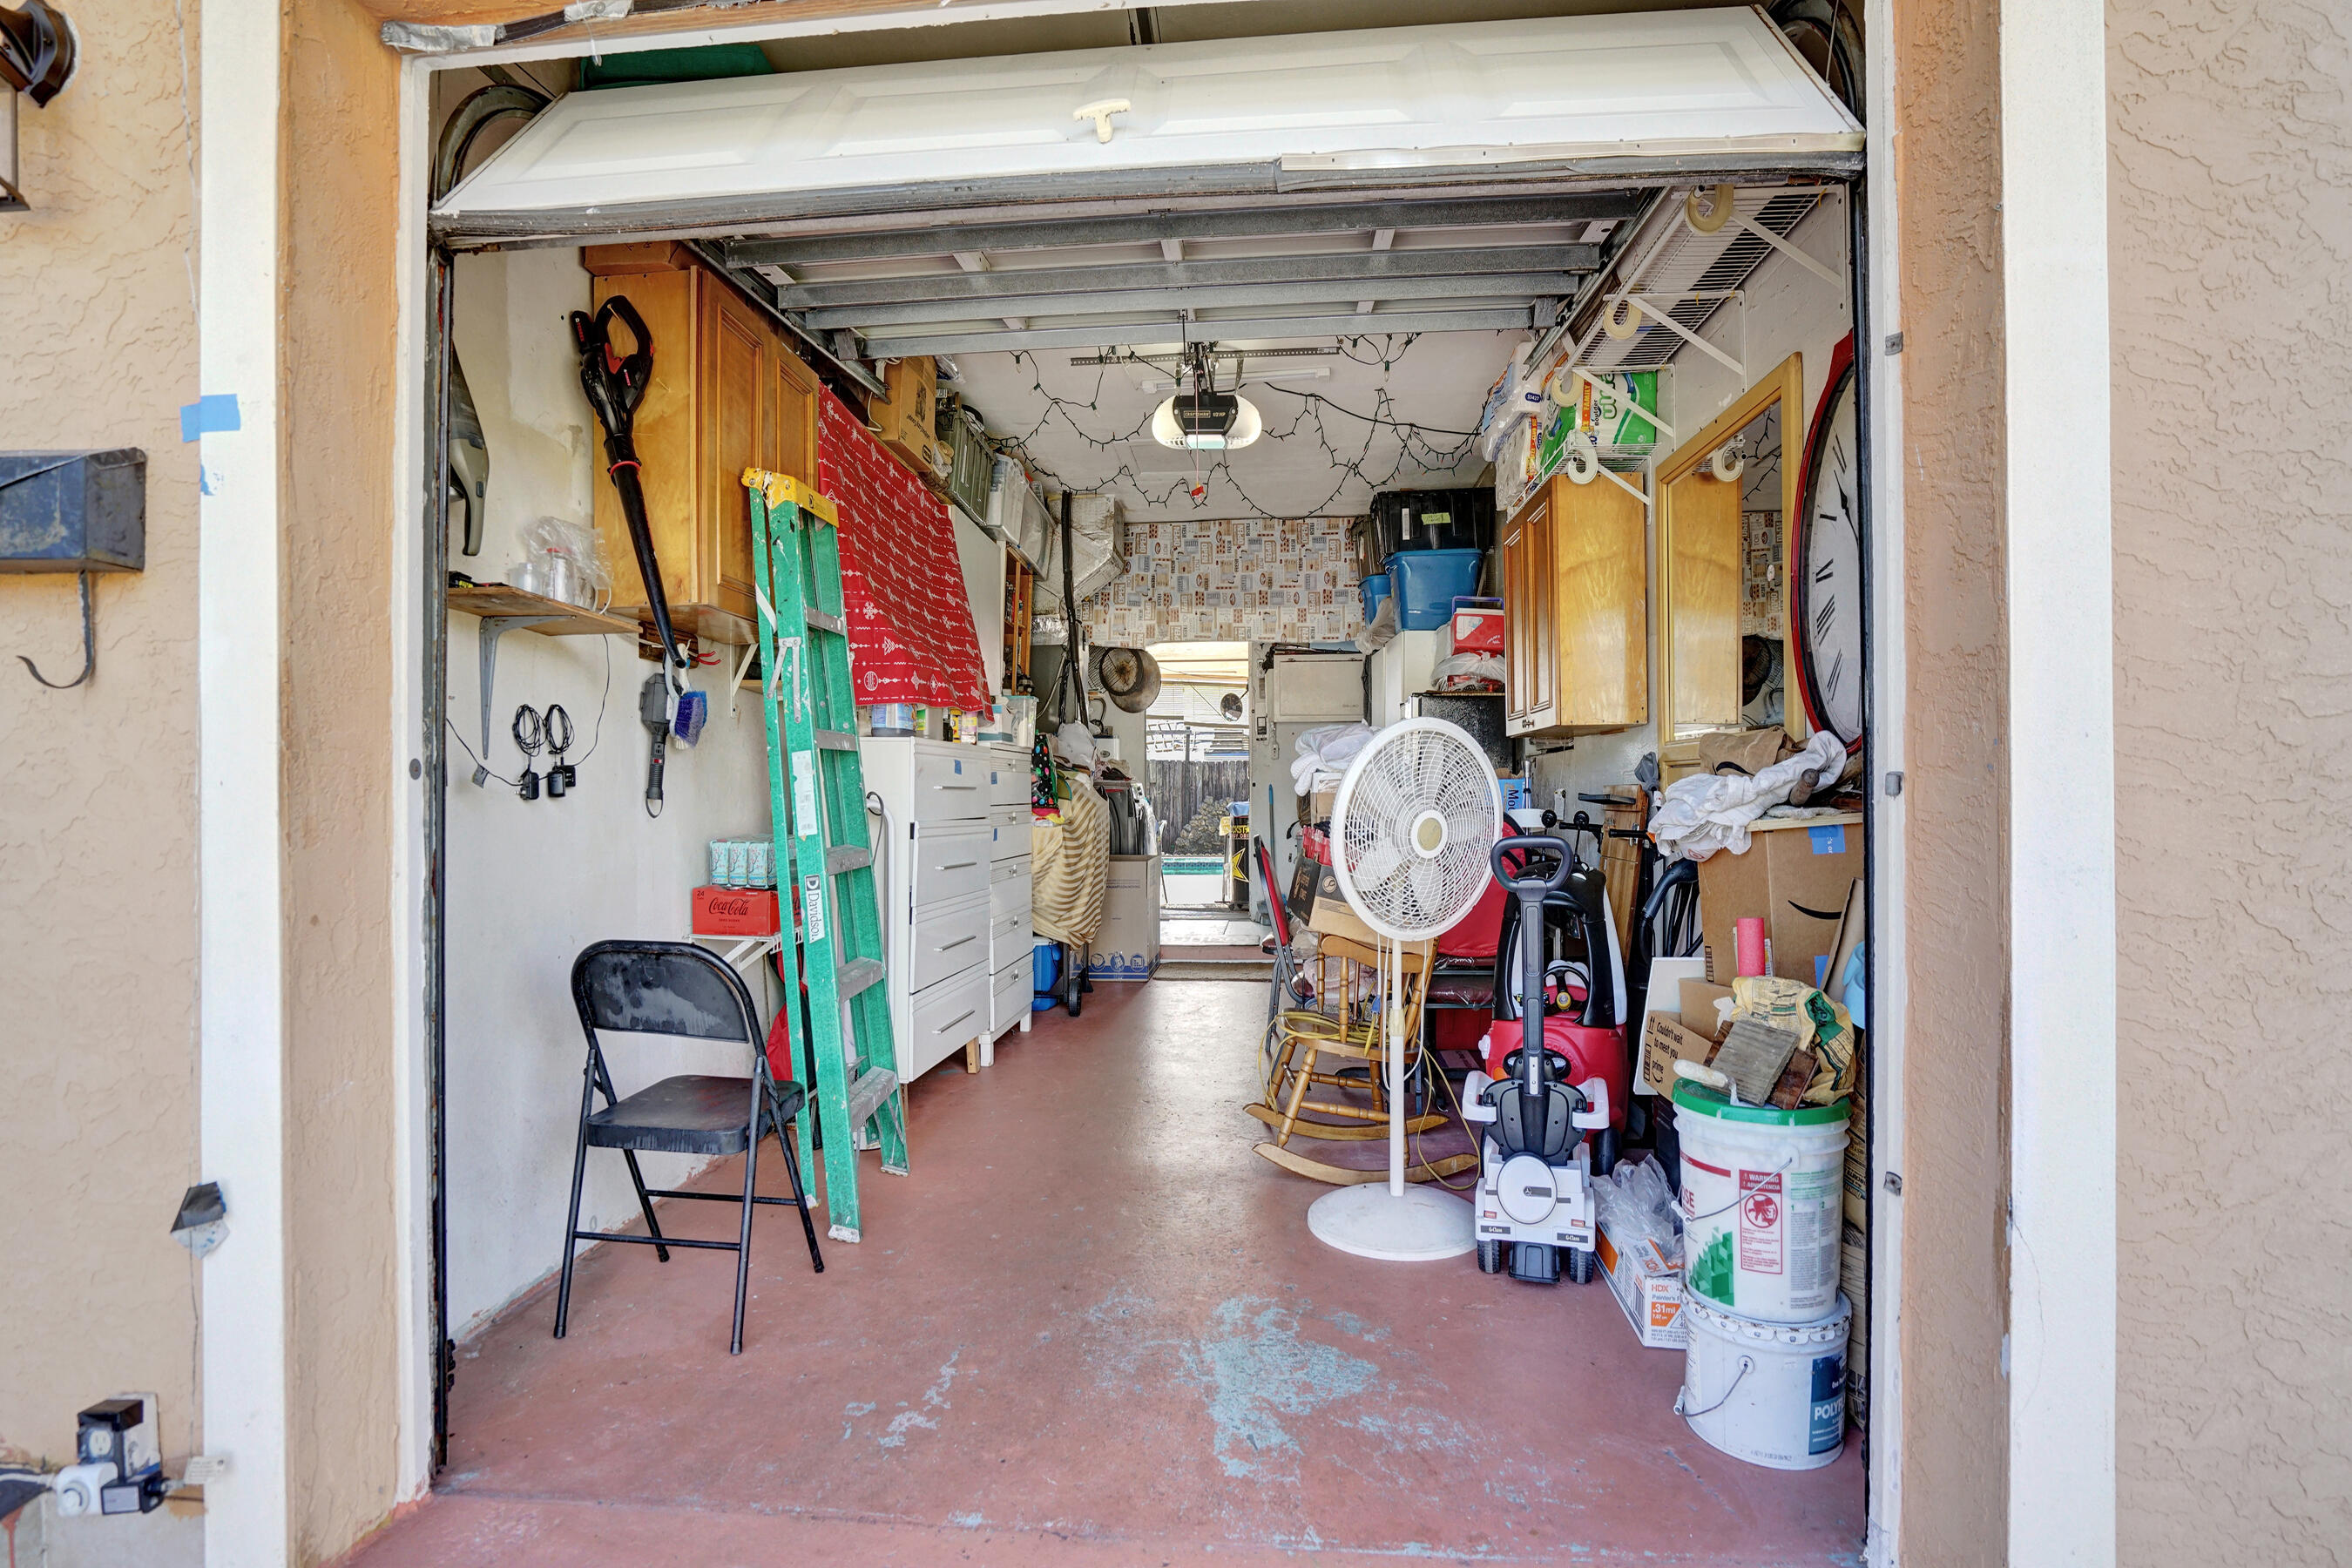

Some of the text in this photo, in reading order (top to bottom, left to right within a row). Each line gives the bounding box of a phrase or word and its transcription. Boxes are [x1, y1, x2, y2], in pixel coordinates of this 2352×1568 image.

[1657, 1022, 1683, 1045] Couldn't wait
[1659, 1042, 1670, 1054] meet
[1670, 1047, 1679, 1059] you
[1652, 1059, 1664, 1074] prime
[1652, 1284, 1669, 1293] HDX
